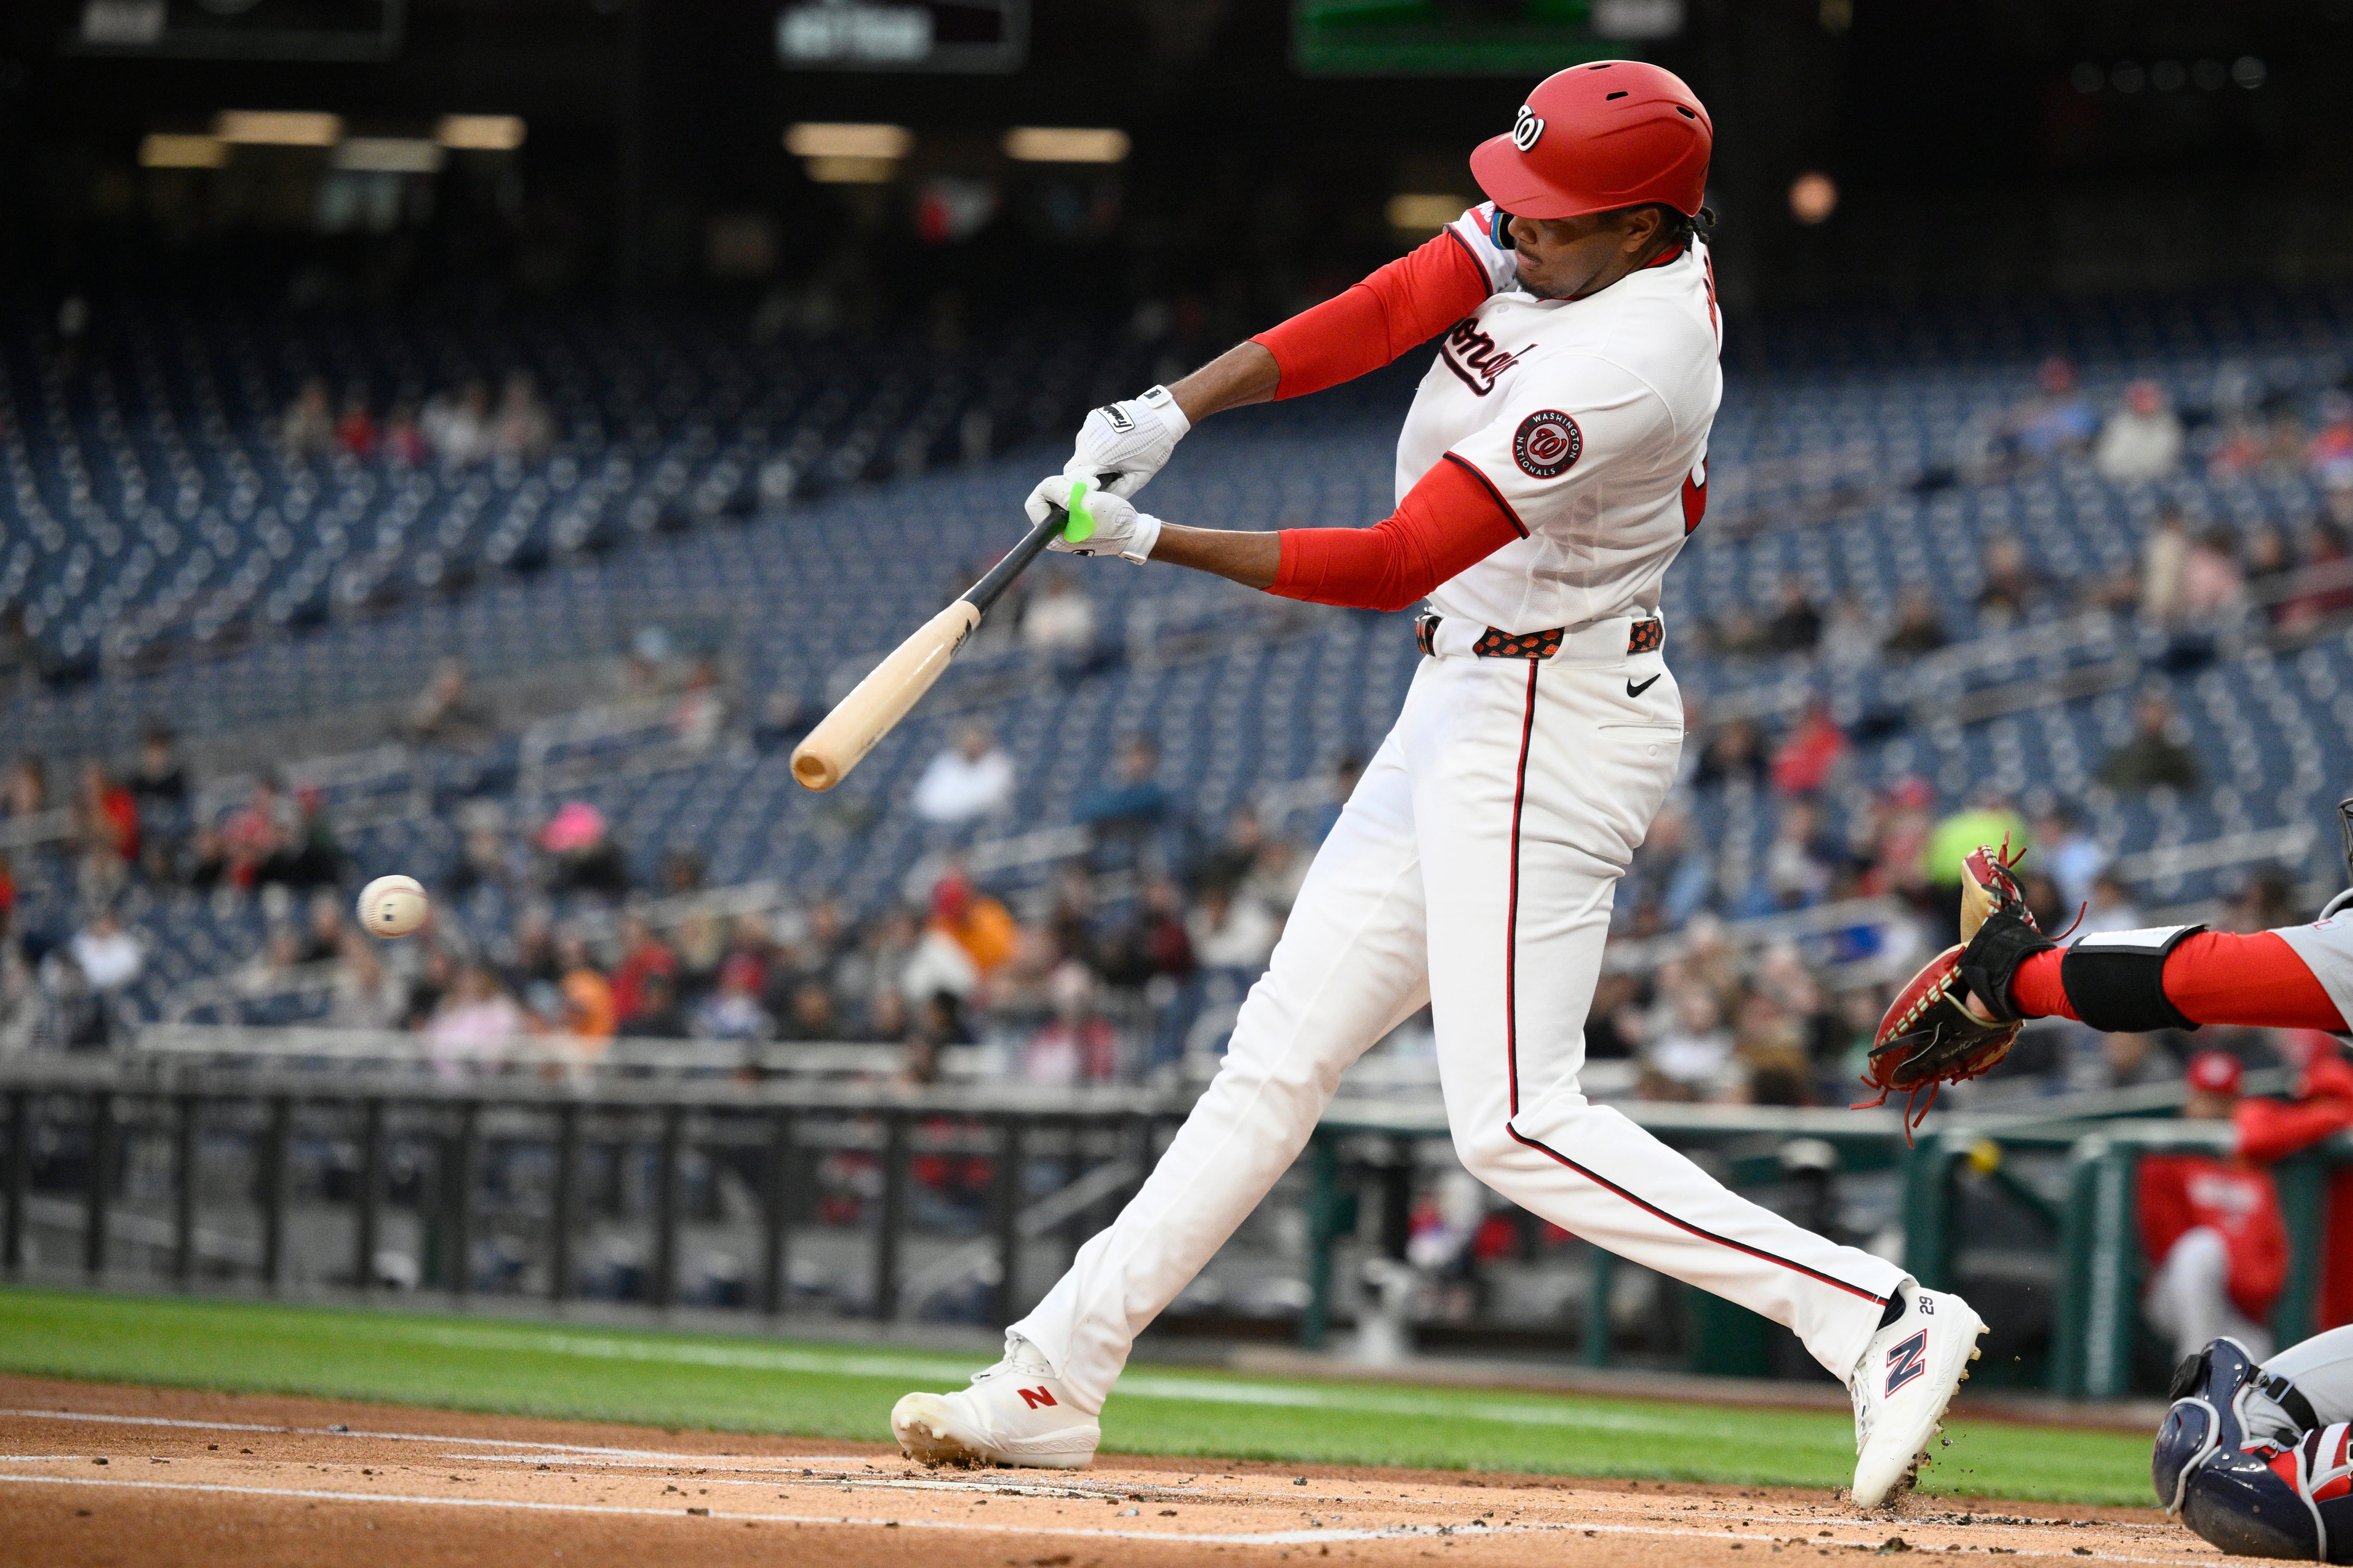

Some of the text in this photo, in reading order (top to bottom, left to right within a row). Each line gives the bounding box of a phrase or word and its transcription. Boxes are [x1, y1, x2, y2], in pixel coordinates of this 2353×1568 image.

[1513, 105, 1546, 153] W
[1529, 428, 1567, 459] W
[1533, 413, 1579, 458] WASHINGTON
[1516, 437, 1555, 476] NATIONALS
[1919, 1296, 1934, 1315] 29
[1885, 1328, 1927, 1399] N
[1017, 1385, 1058, 1410] N
